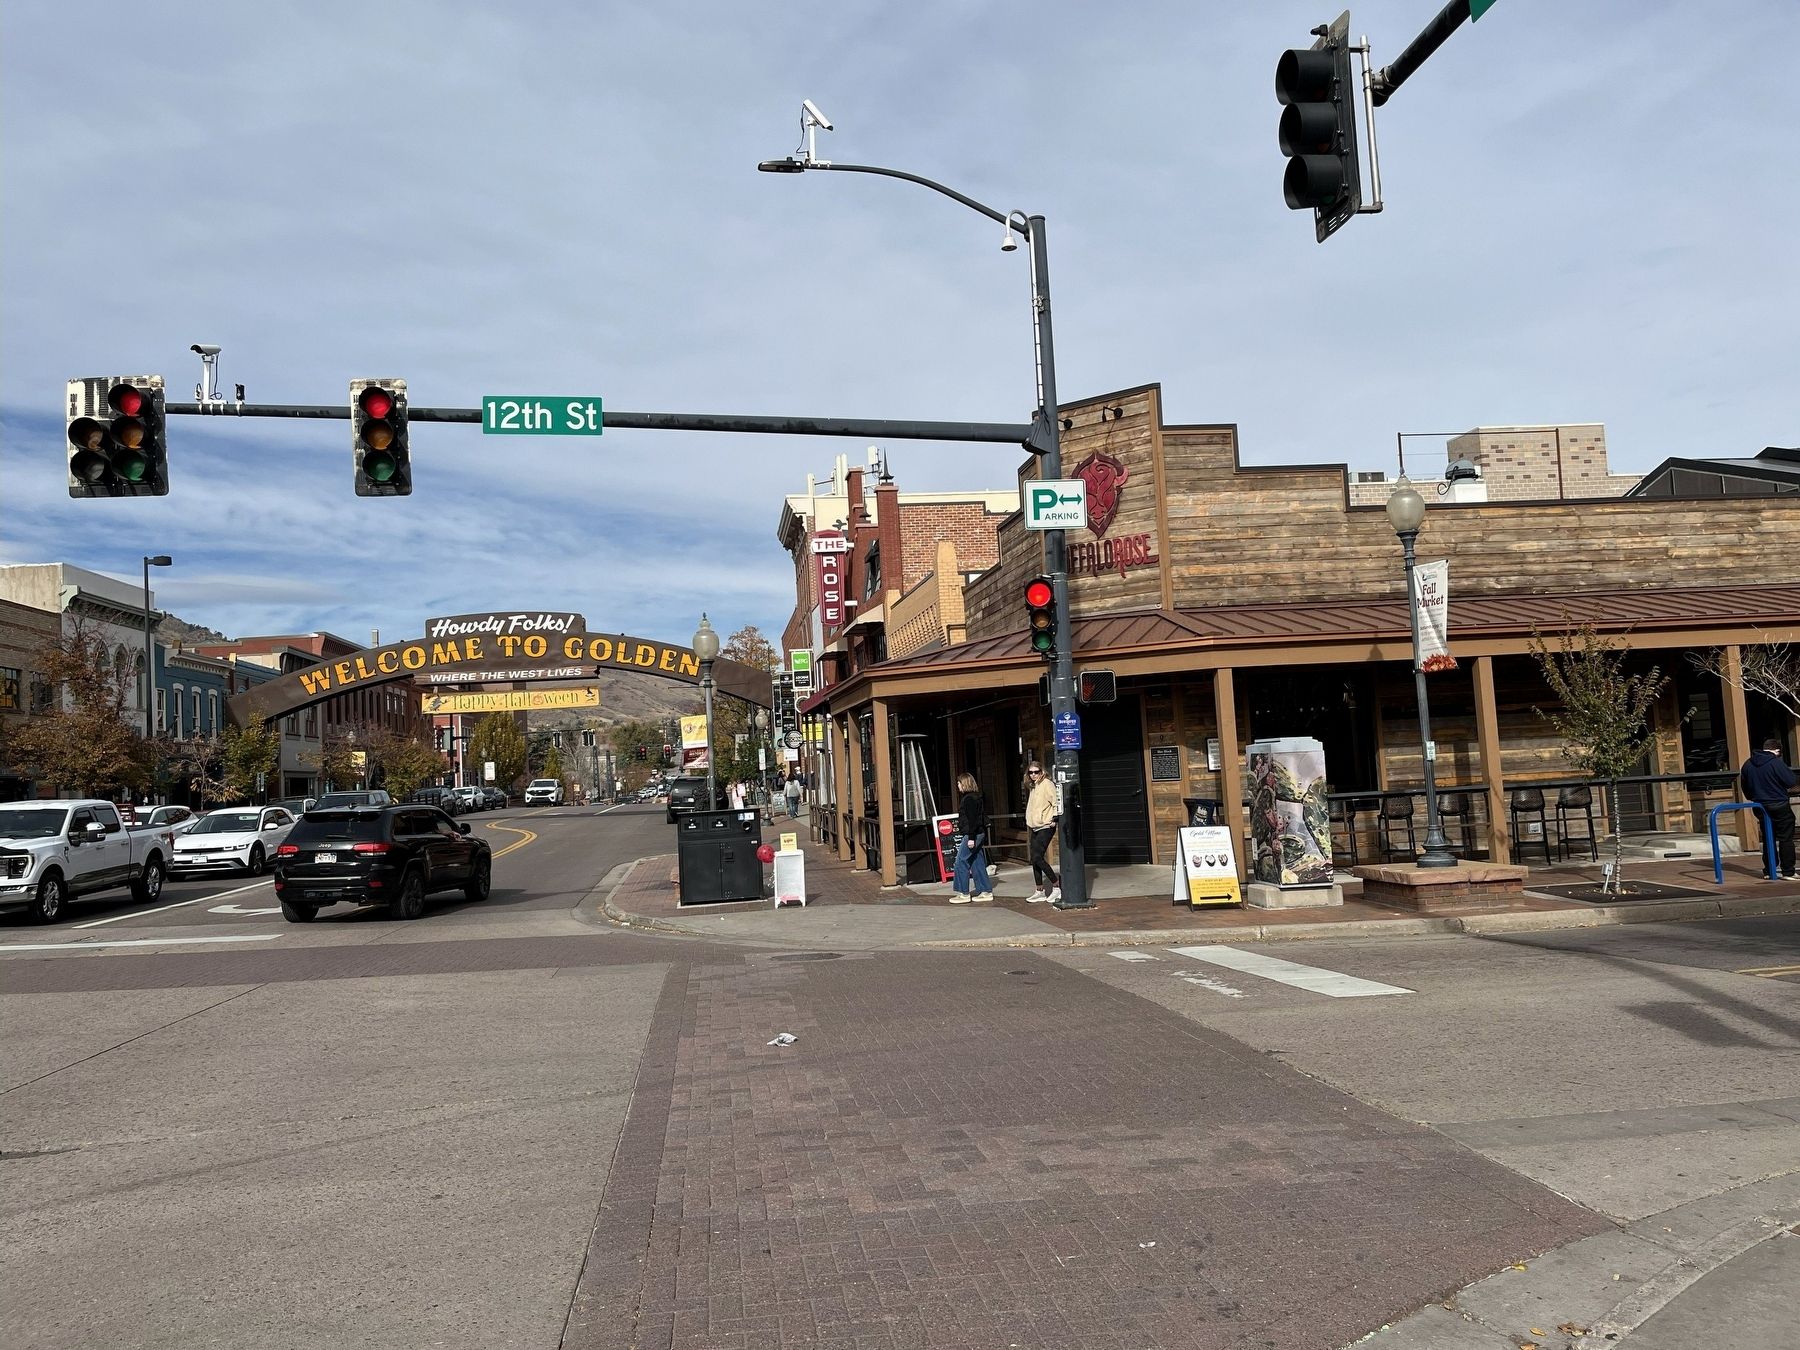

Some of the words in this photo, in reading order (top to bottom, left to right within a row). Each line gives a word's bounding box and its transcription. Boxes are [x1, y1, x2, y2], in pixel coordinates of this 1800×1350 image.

[487, 401, 552, 429] 12th
[566, 402, 597, 430] St
[815, 541, 844, 550] THE
[823, 556, 839, 620] ROSE
[1422, 582, 1437, 596] Fall
[431, 616, 505, 638] Howdy
[507, 614, 575, 635] Folks!
[299, 636, 484, 696] WELCOME
[496, 635, 548, 658] TO
[563, 637, 700, 677] GOLDEN
[430, 672, 476, 682] WHERE
[480, 671, 505, 680] THE
[509, 669, 545, 679] WEST
[547, 668, 582, 677] LIVES
[452, 693, 500, 709] Happy
